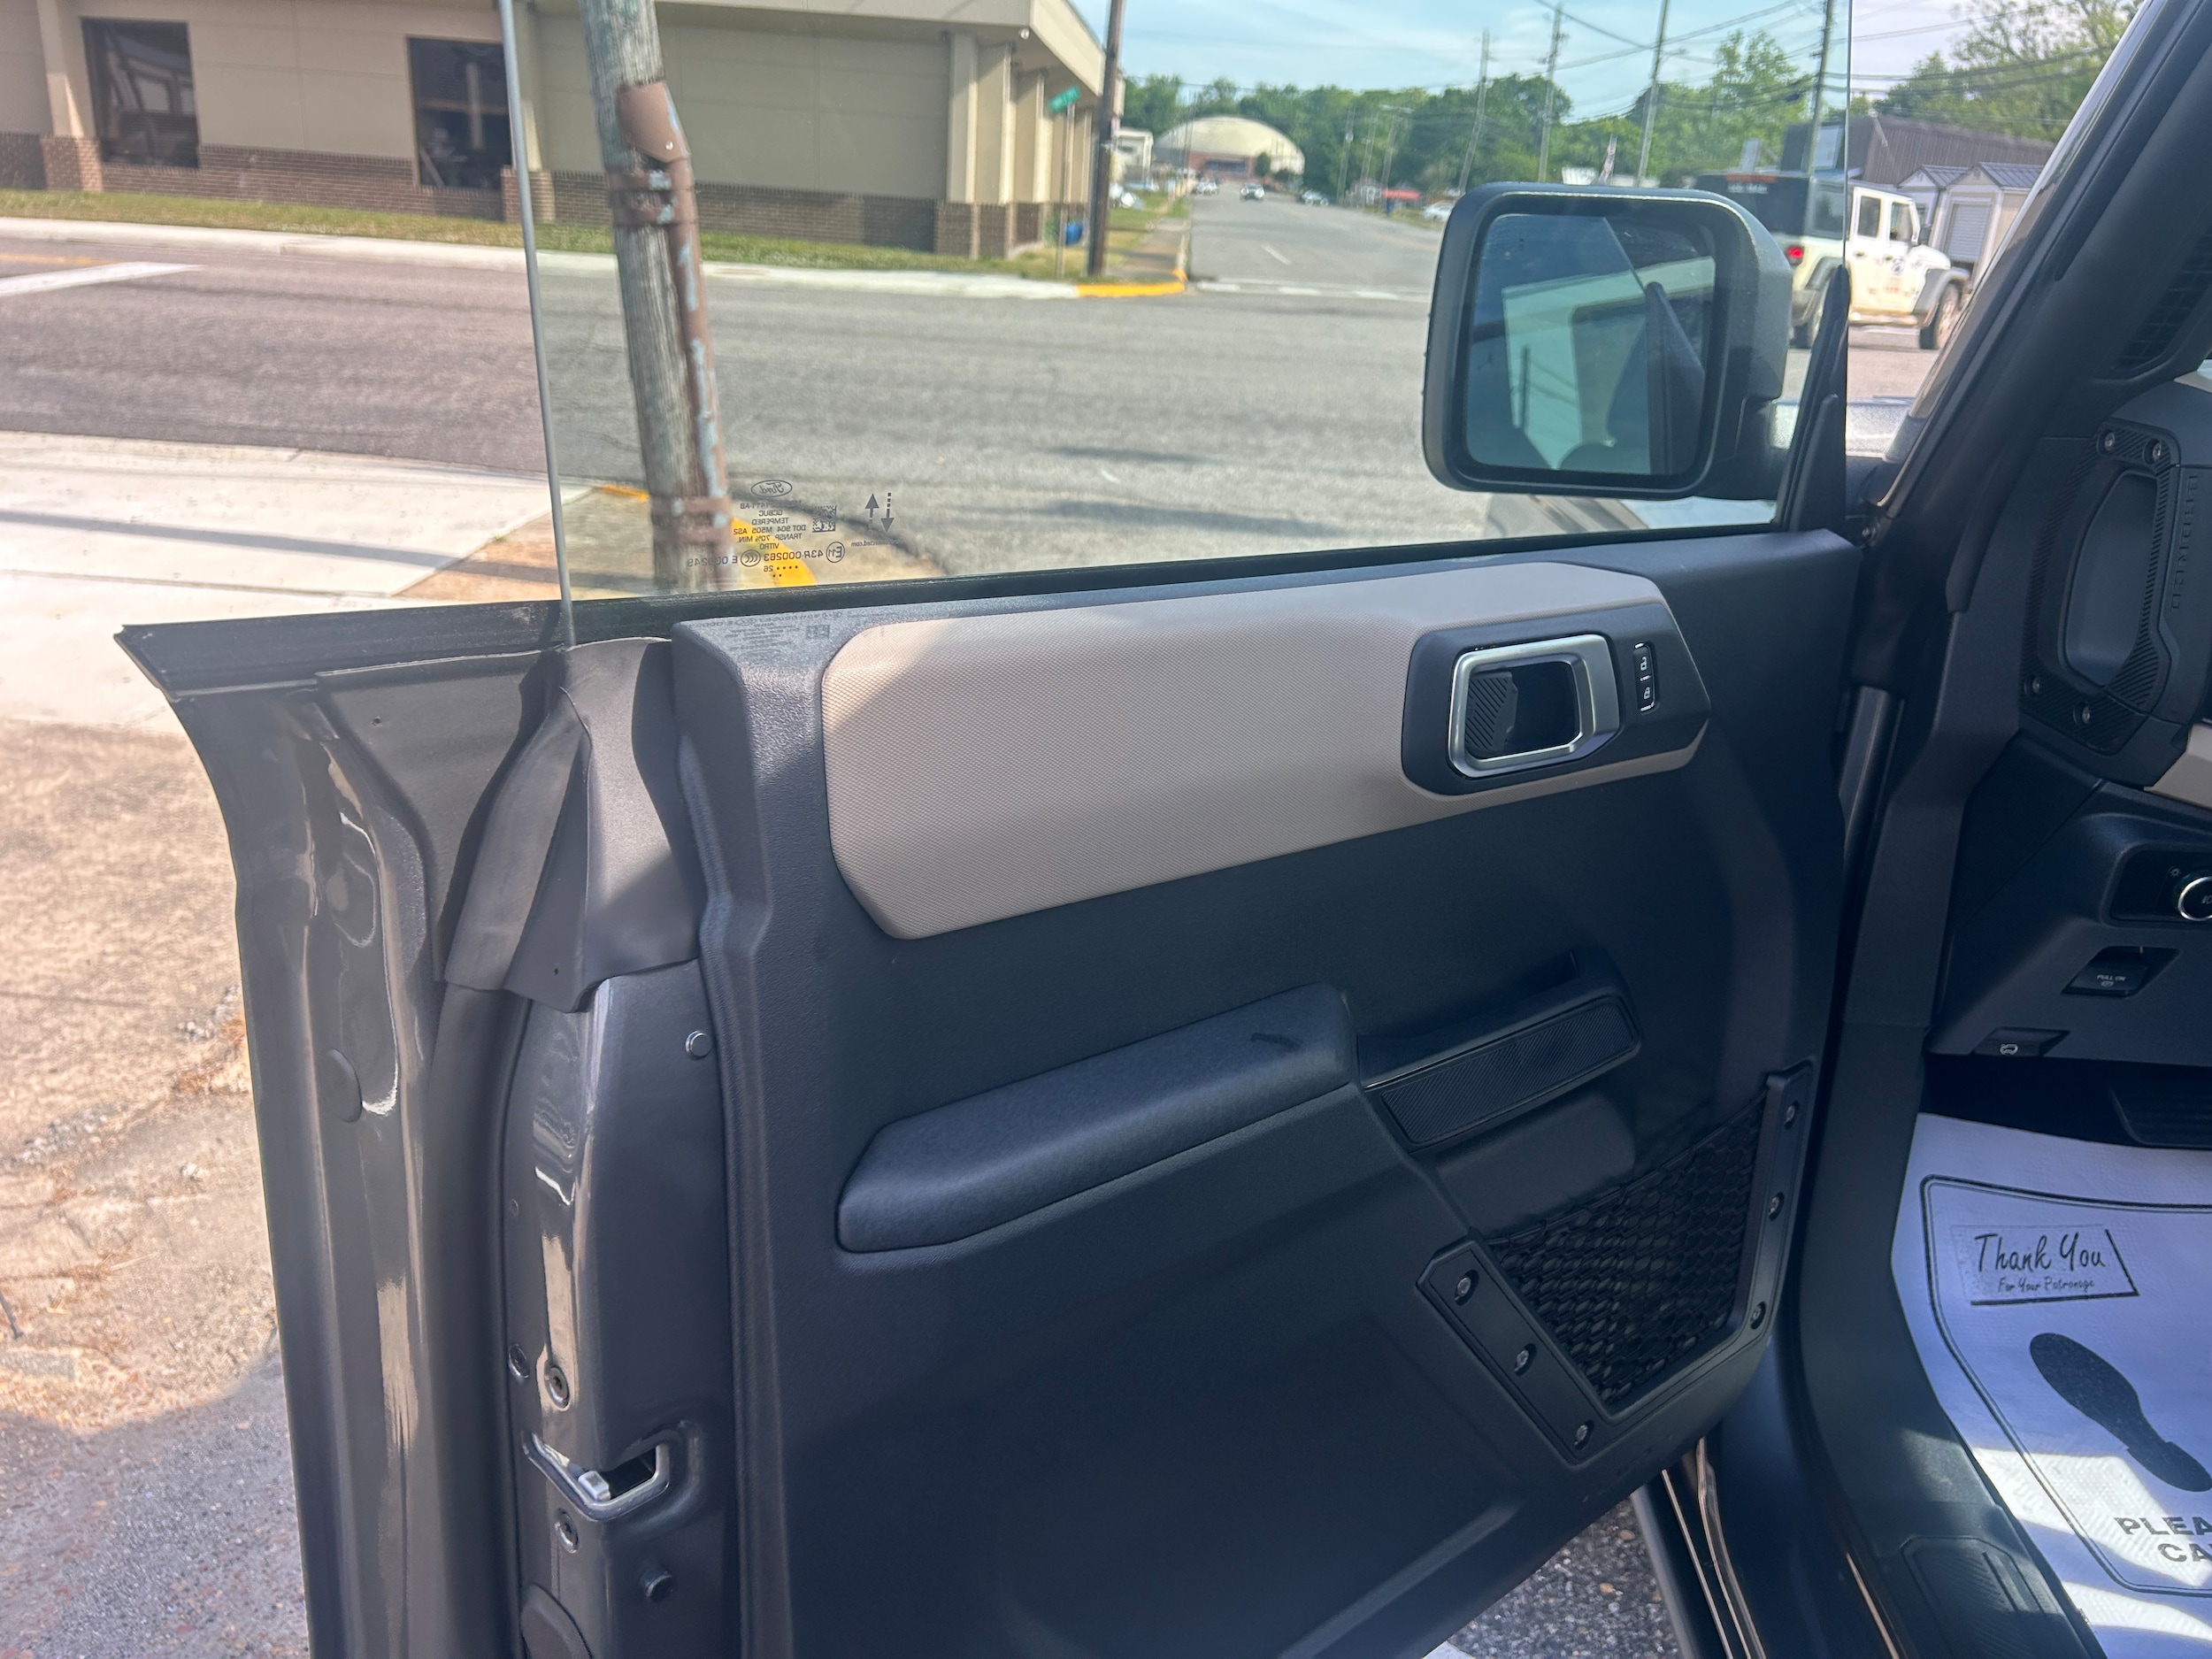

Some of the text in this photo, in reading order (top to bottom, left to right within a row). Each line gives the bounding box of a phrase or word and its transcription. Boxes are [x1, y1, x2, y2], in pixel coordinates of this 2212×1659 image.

[1974, 1231, 2106, 1272] Thank You
[1998, 1275, 2095, 1294] For Your Patronage
[2157, 1543, 2212, 1563] CA
